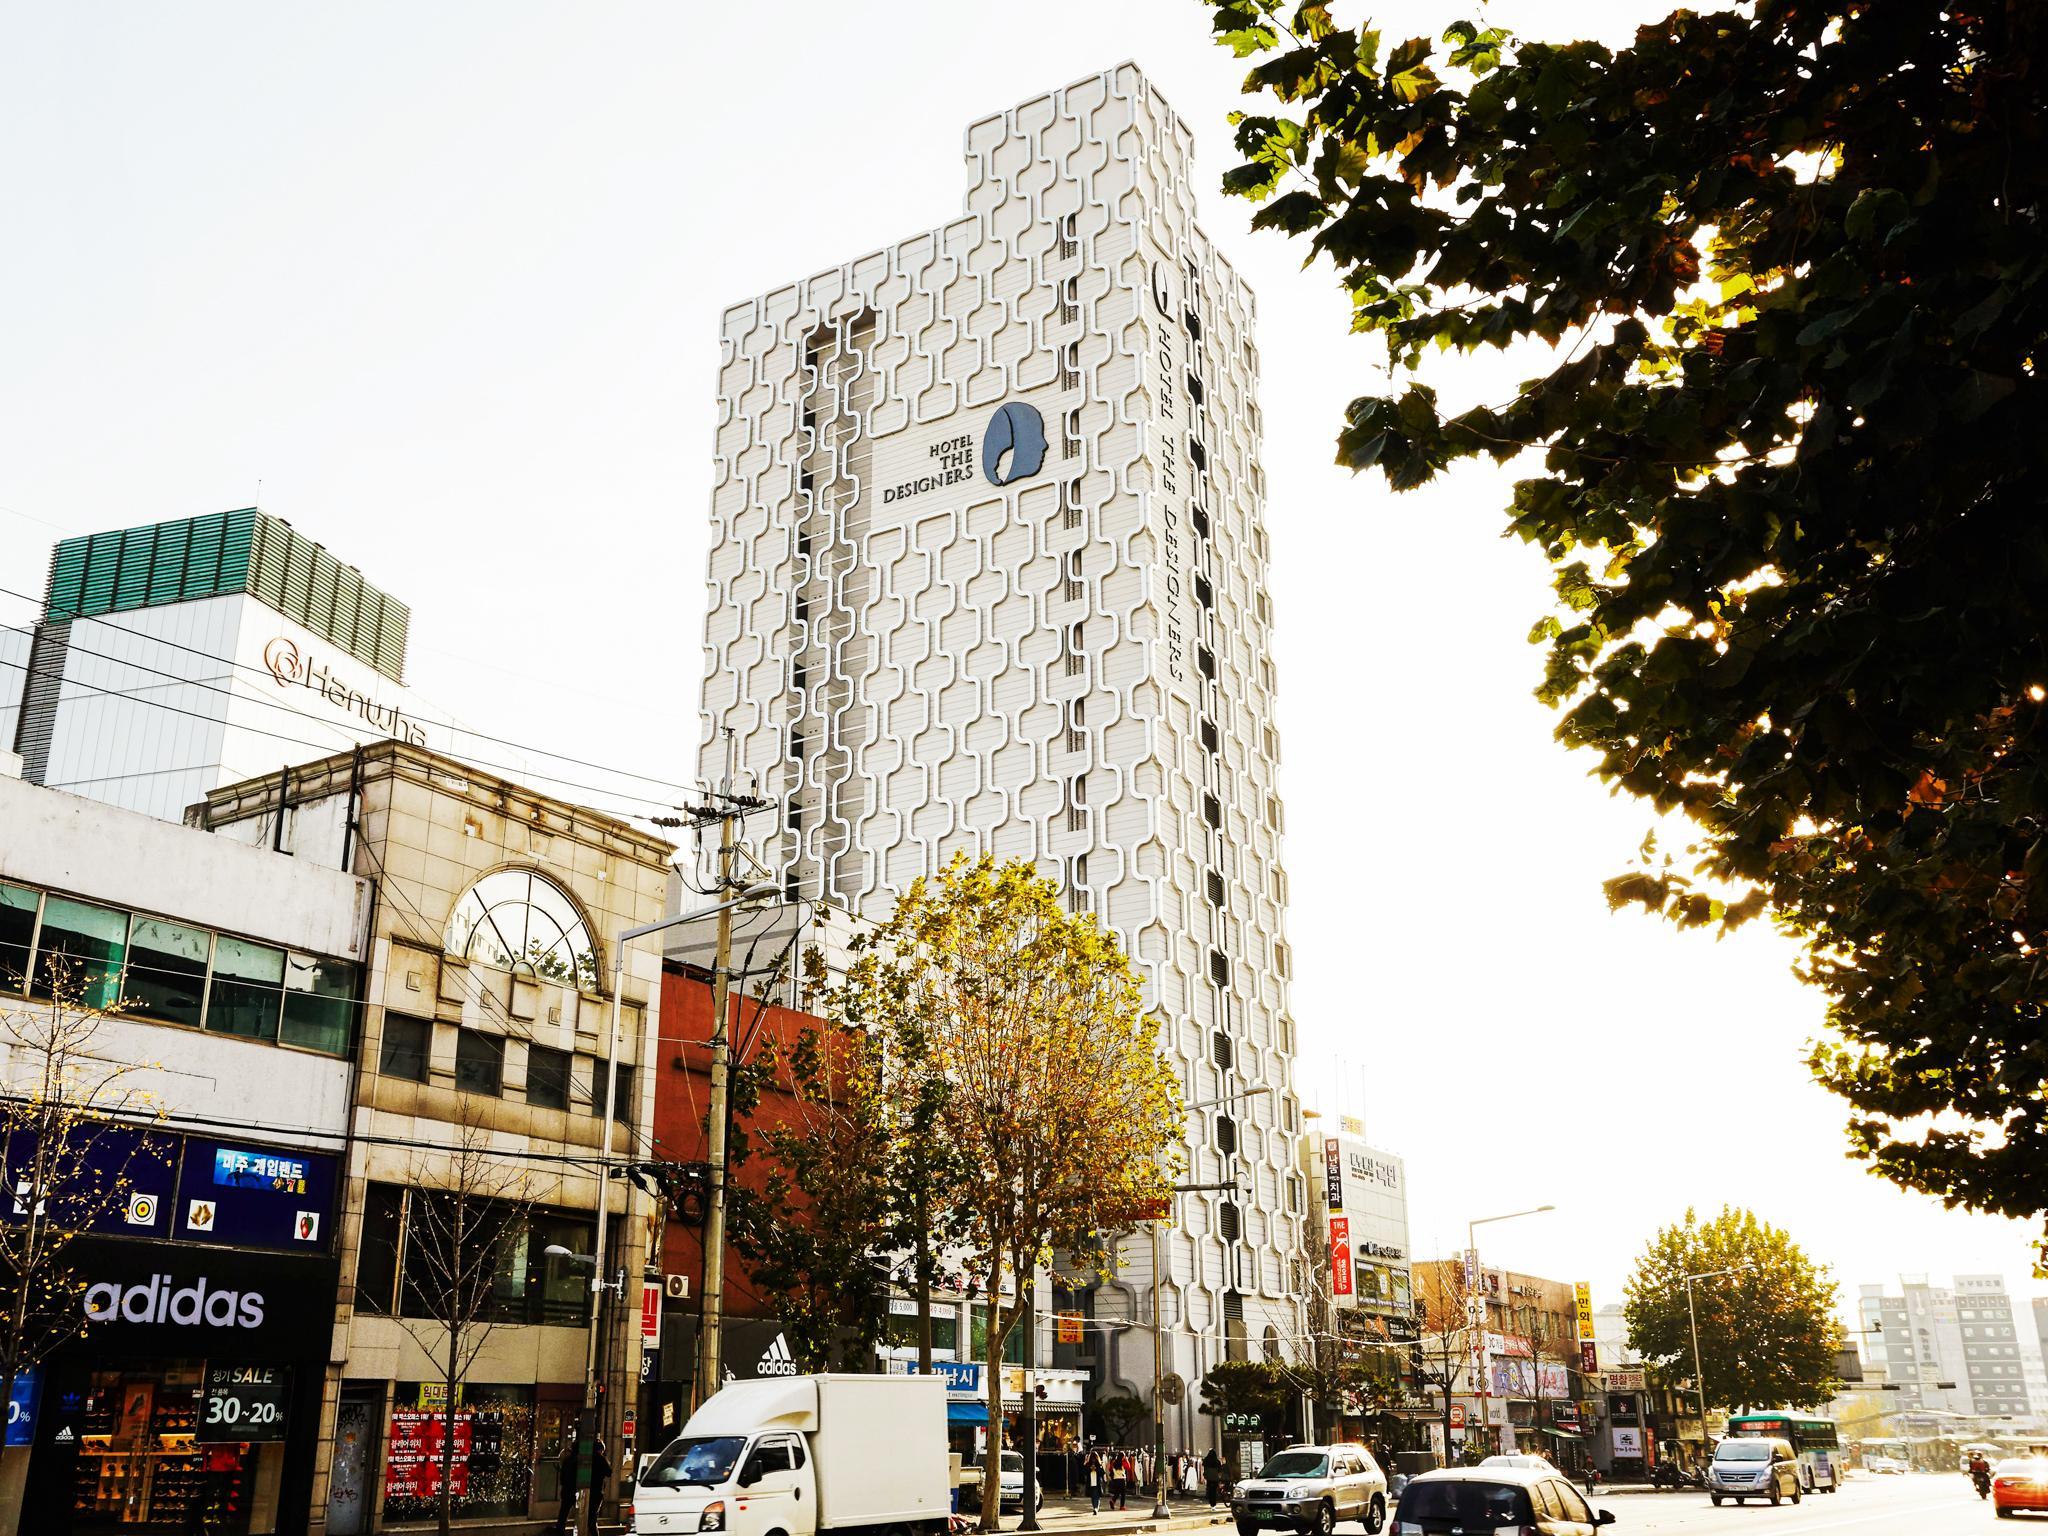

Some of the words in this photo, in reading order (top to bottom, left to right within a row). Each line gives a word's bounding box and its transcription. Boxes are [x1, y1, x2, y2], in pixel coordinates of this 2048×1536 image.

[1158, 323, 1174, 420] HOTEL
[929, 434, 974, 458] HOTEL
[939, 448, 973, 470] THE
[1162, 434, 1176, 495] THE
[882, 464, 974, 503] DESIGNERS
[1164, 504, 1183, 682] DESIGNERS
[306, 656, 426, 746] Hanwha
[1333, 1221, 1346, 1230] THE
[83, 1273, 265, 1328] adidas
[212, 1369, 230, 1382] 정기
[231, 1367, 275, 1384] SALE
[757, 1359, 797, 1375] adidas
